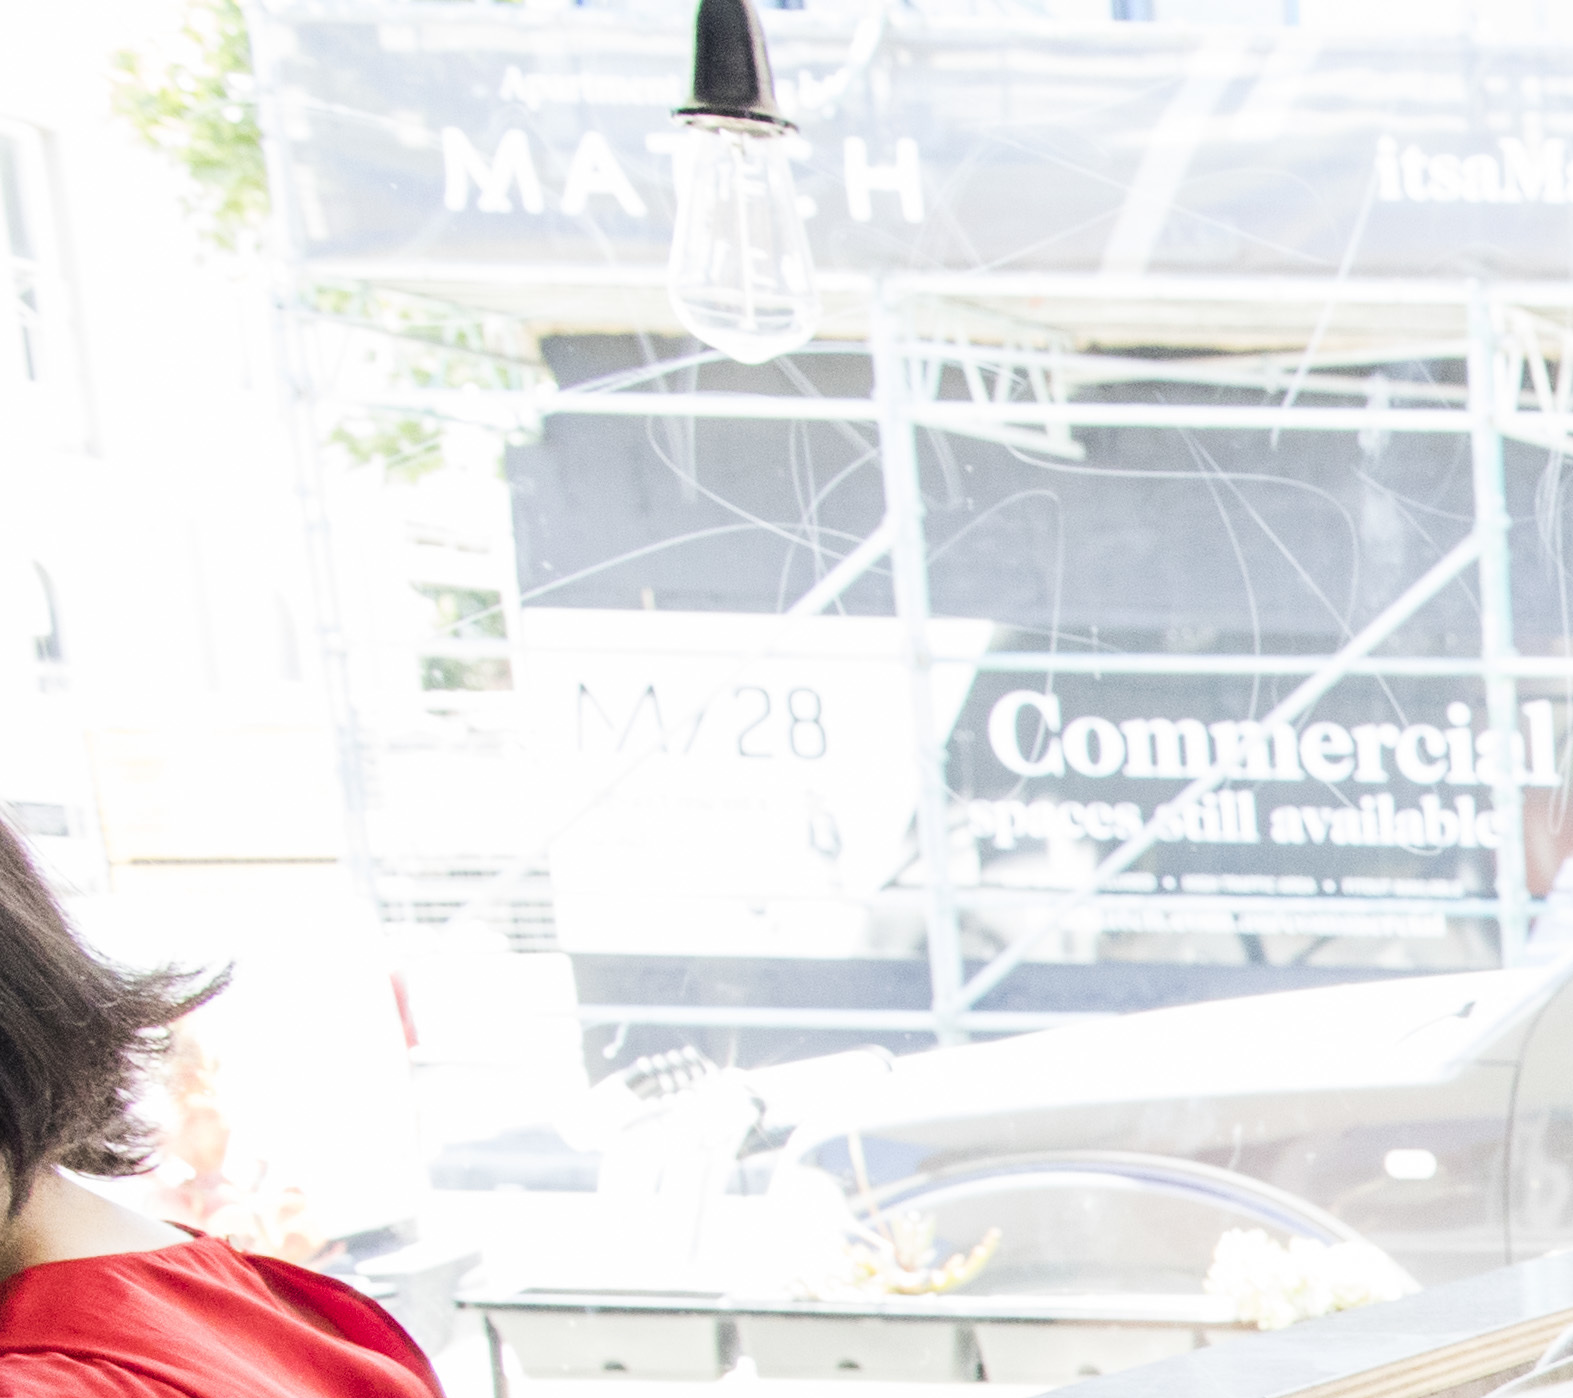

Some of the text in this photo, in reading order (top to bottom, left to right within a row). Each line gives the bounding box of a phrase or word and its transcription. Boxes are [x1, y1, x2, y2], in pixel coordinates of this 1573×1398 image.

[988, 689, 1561, 787] Commercial
[967, 799, 1142, 850] spaces
[1156, 790, 1260, 845] still
